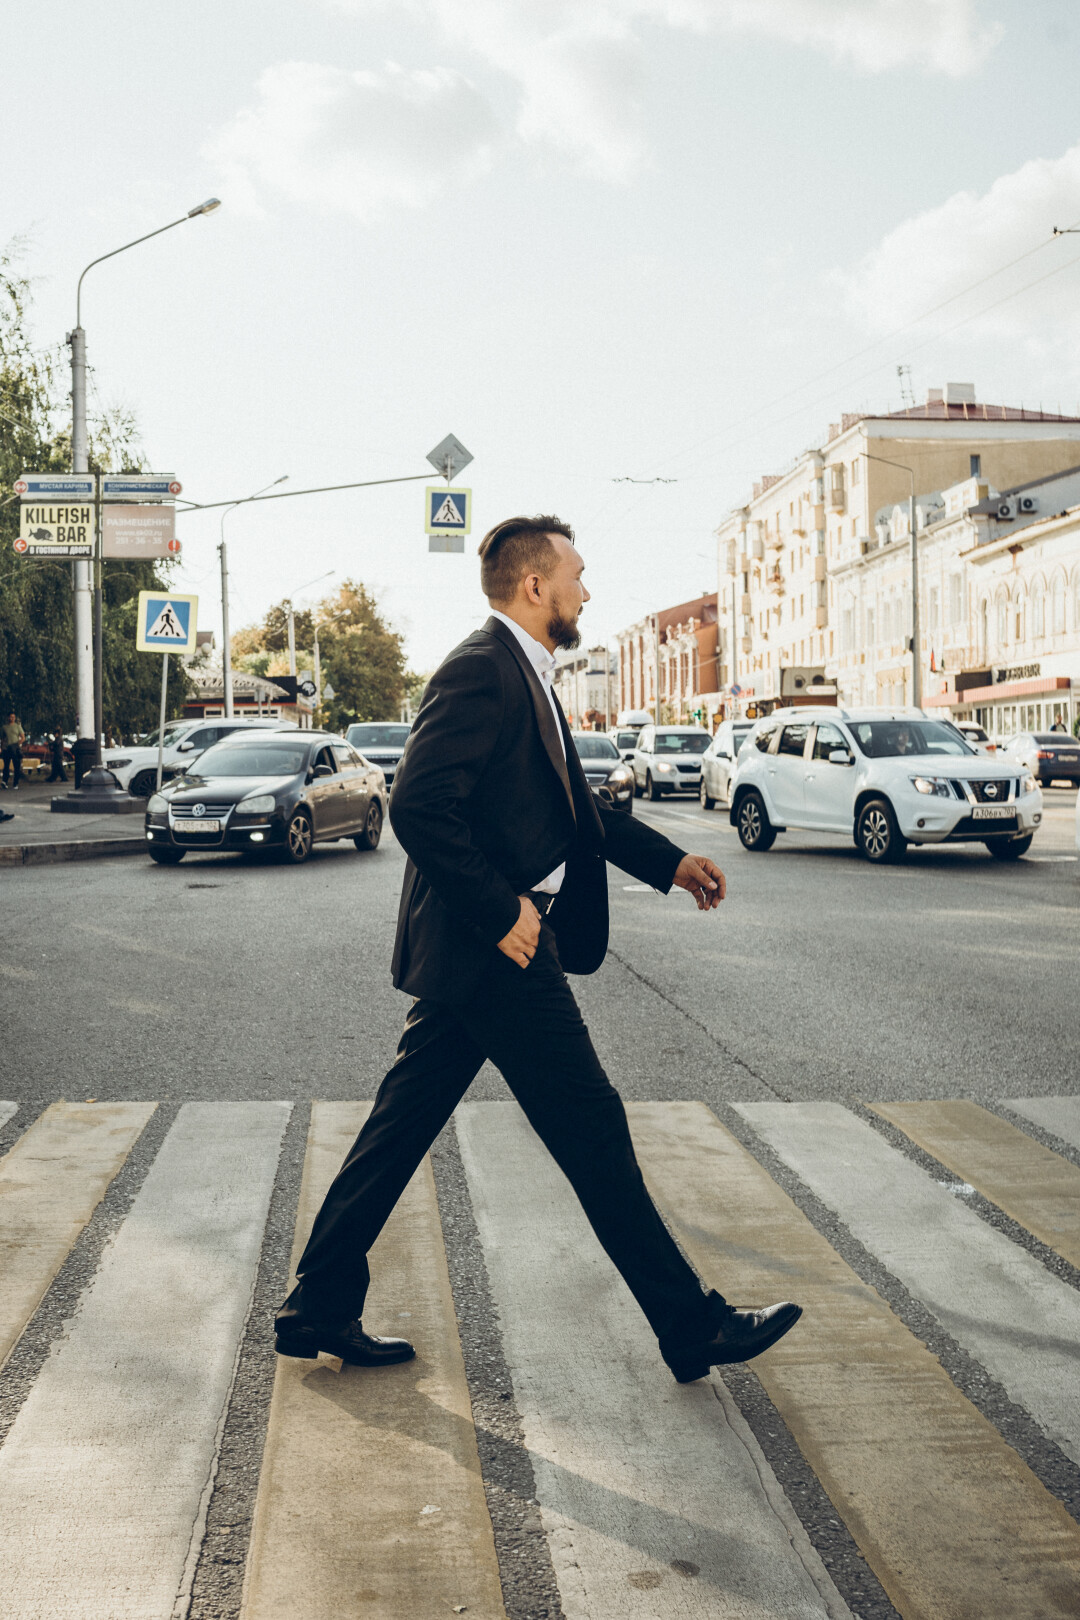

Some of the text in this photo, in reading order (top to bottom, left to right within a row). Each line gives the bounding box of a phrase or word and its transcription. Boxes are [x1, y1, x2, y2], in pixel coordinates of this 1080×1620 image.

[26, 507, 90, 524] KILLFISH
[106, 518, 171, 527] РАЗМЕЩЕНИЕ
[57, 526, 86, 542] BAR
[29, 546, 90, 555] В ГОСТИНОМ ДВОРЕ
